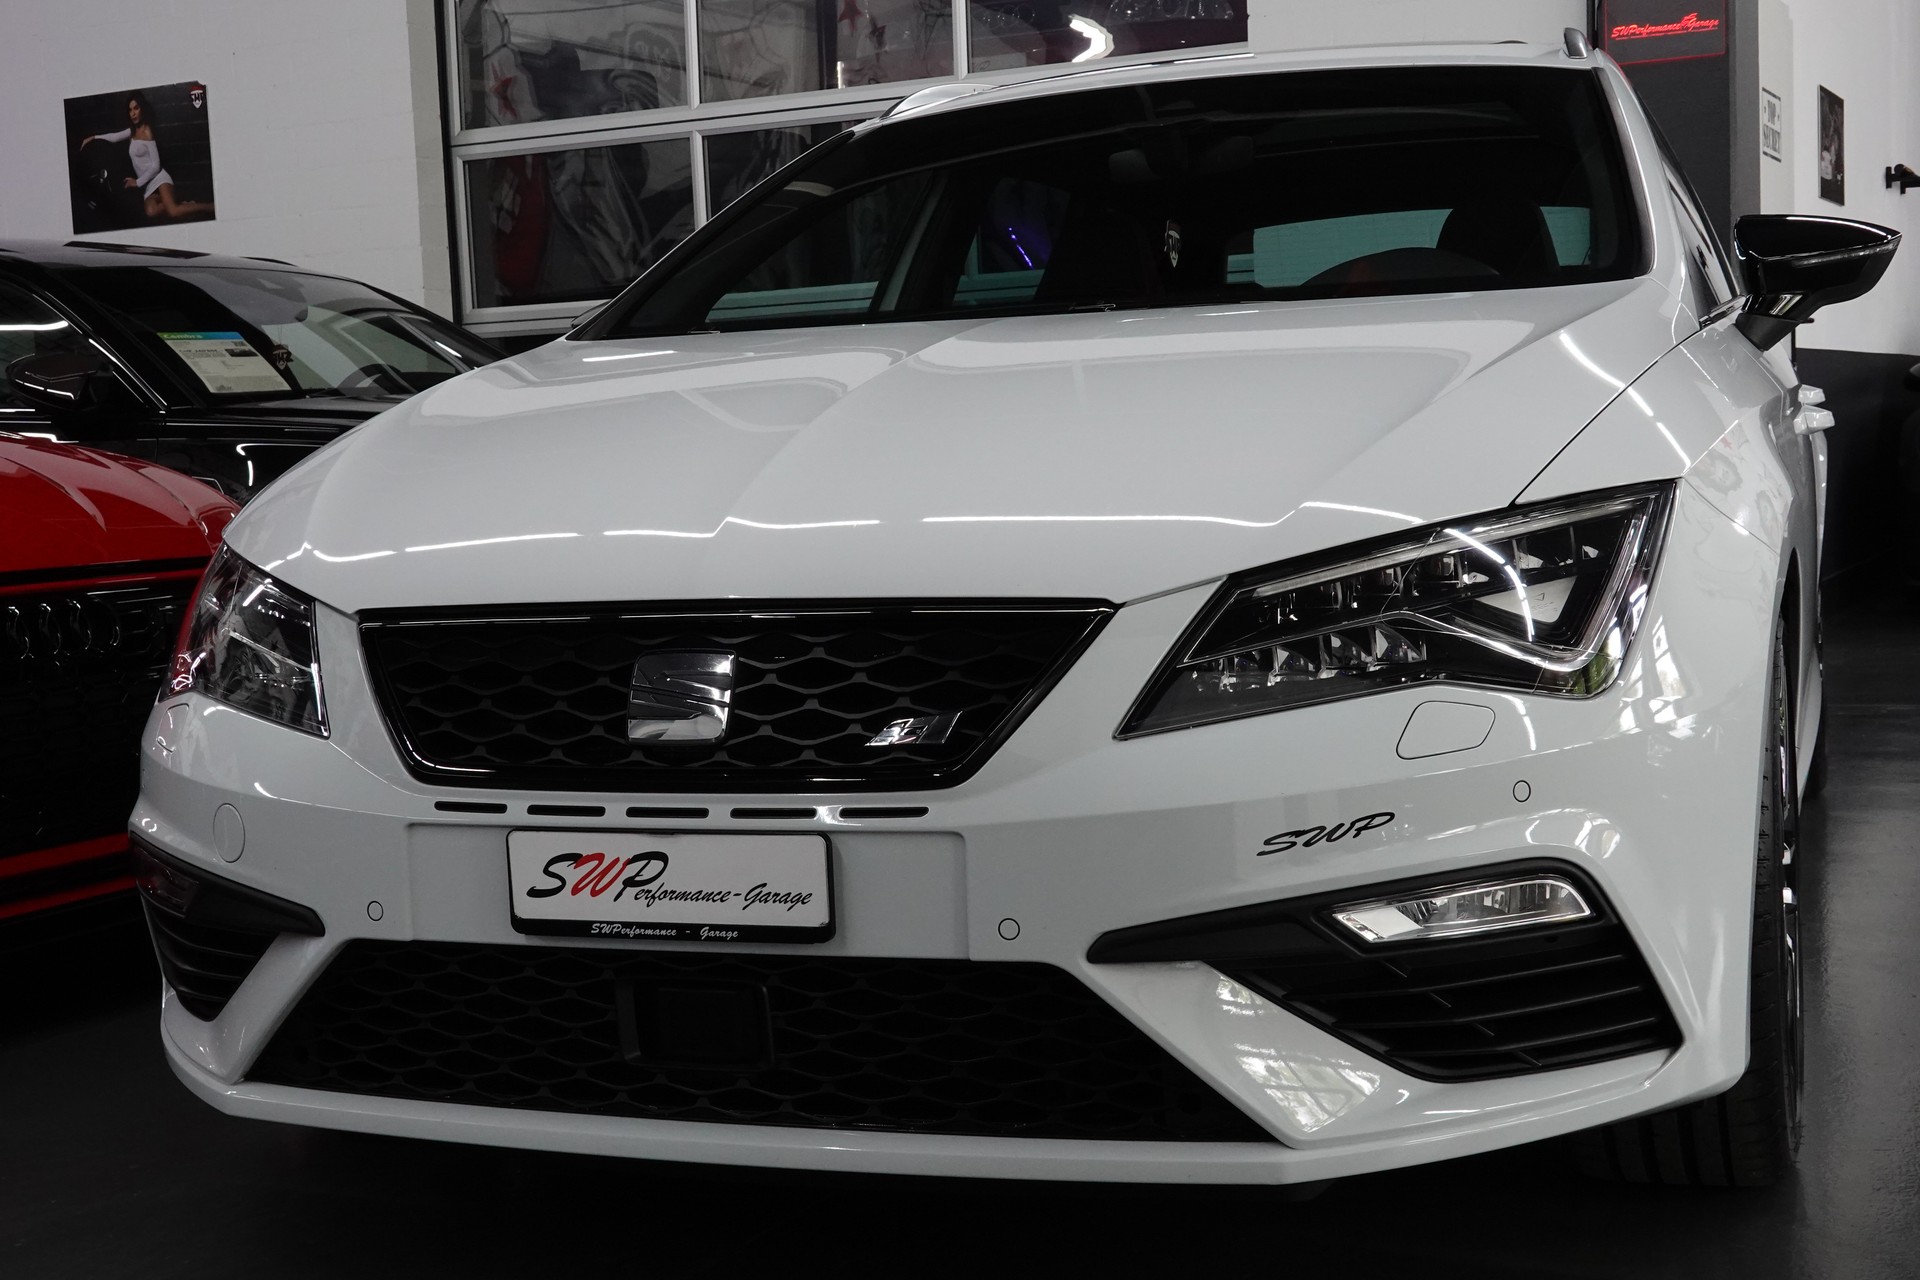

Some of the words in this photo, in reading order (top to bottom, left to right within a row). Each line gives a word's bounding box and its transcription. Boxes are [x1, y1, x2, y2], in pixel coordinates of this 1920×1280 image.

[1256, 811, 1396, 857] SWP
[590, 922, 677, 938] SWPerformance
[699, 926, 739, 940] Garage
